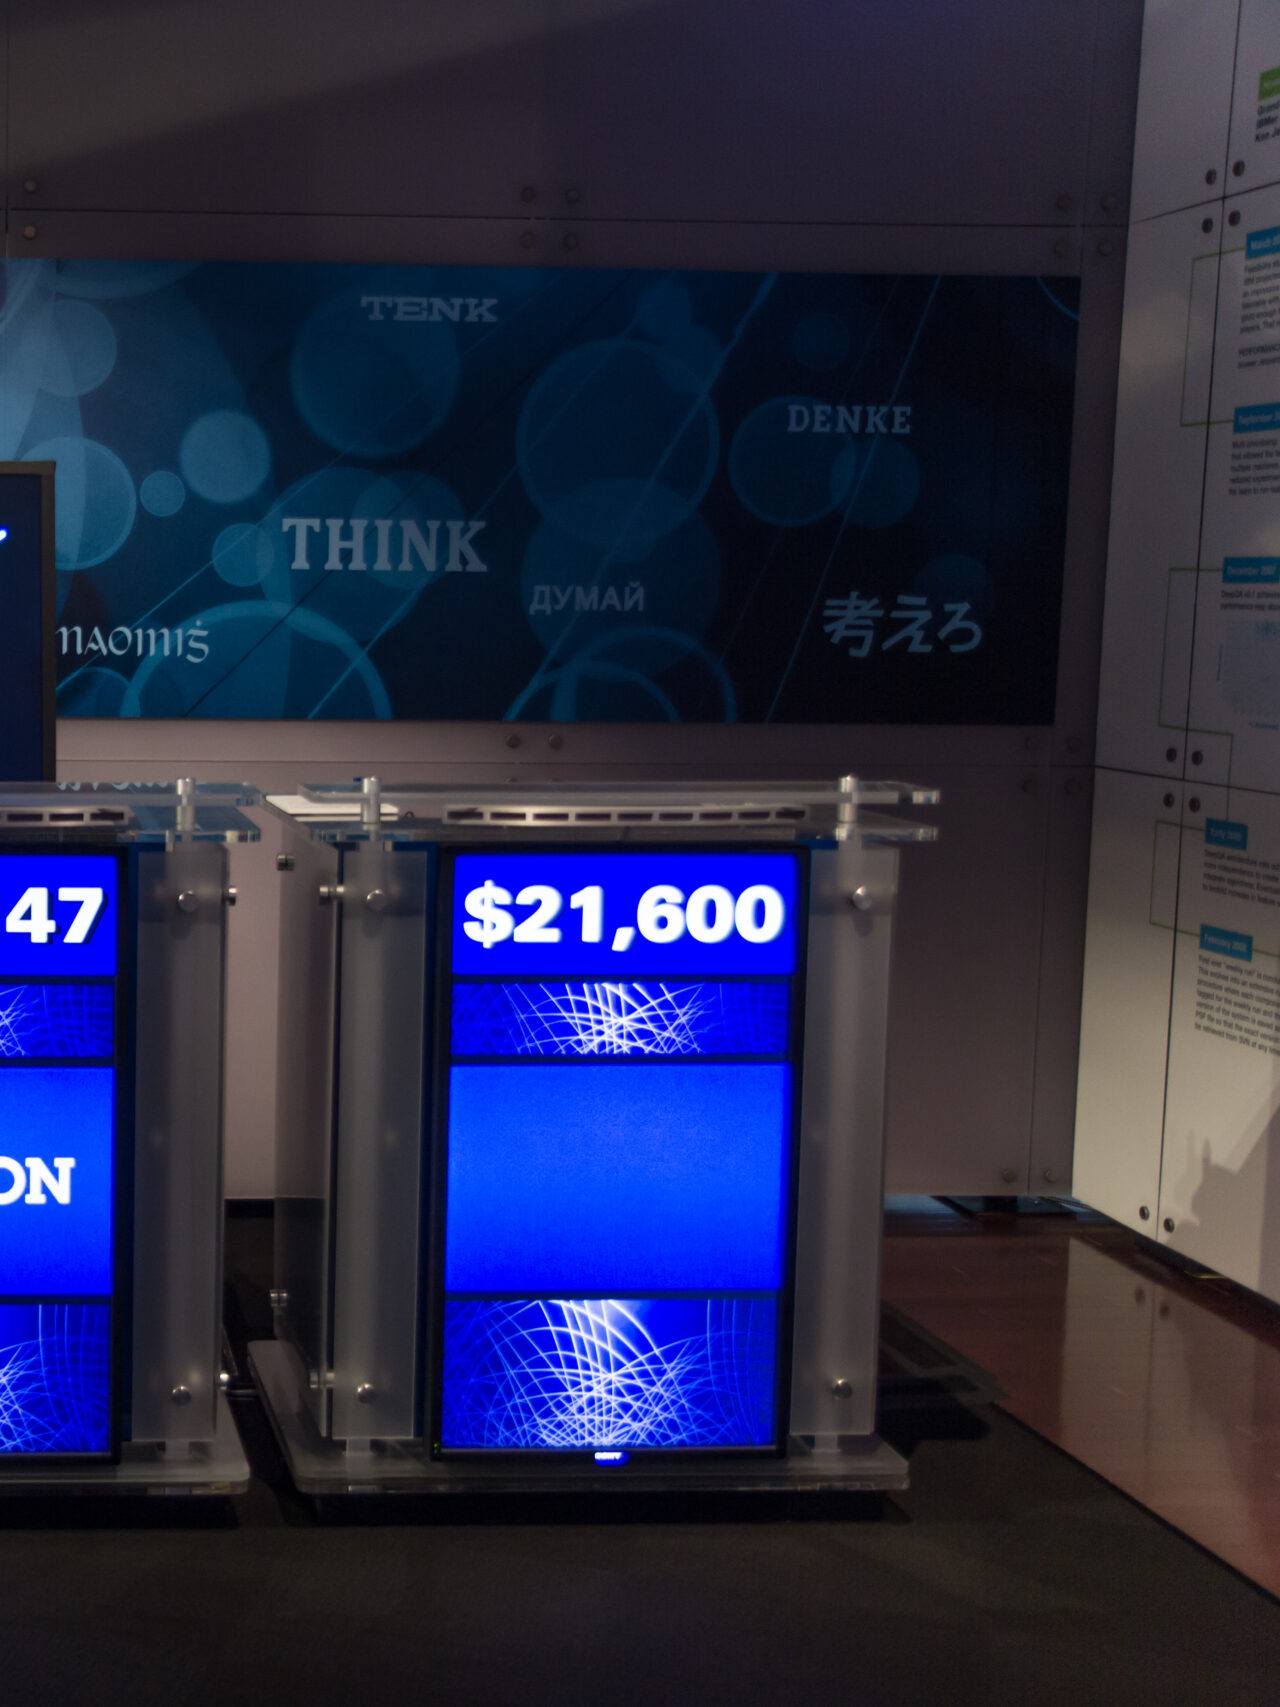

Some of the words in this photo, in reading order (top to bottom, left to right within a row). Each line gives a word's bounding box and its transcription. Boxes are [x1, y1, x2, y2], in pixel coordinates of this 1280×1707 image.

[361, 295, 498, 323] TENK
[787, 404, 912, 434] DENKE
[281, 517, 488, 573] THINK
[529, 581, 645, 615] ДУМАЙ
[823, 591, 983, 657] 考えろ
[463, 880, 786, 952] $21,600
